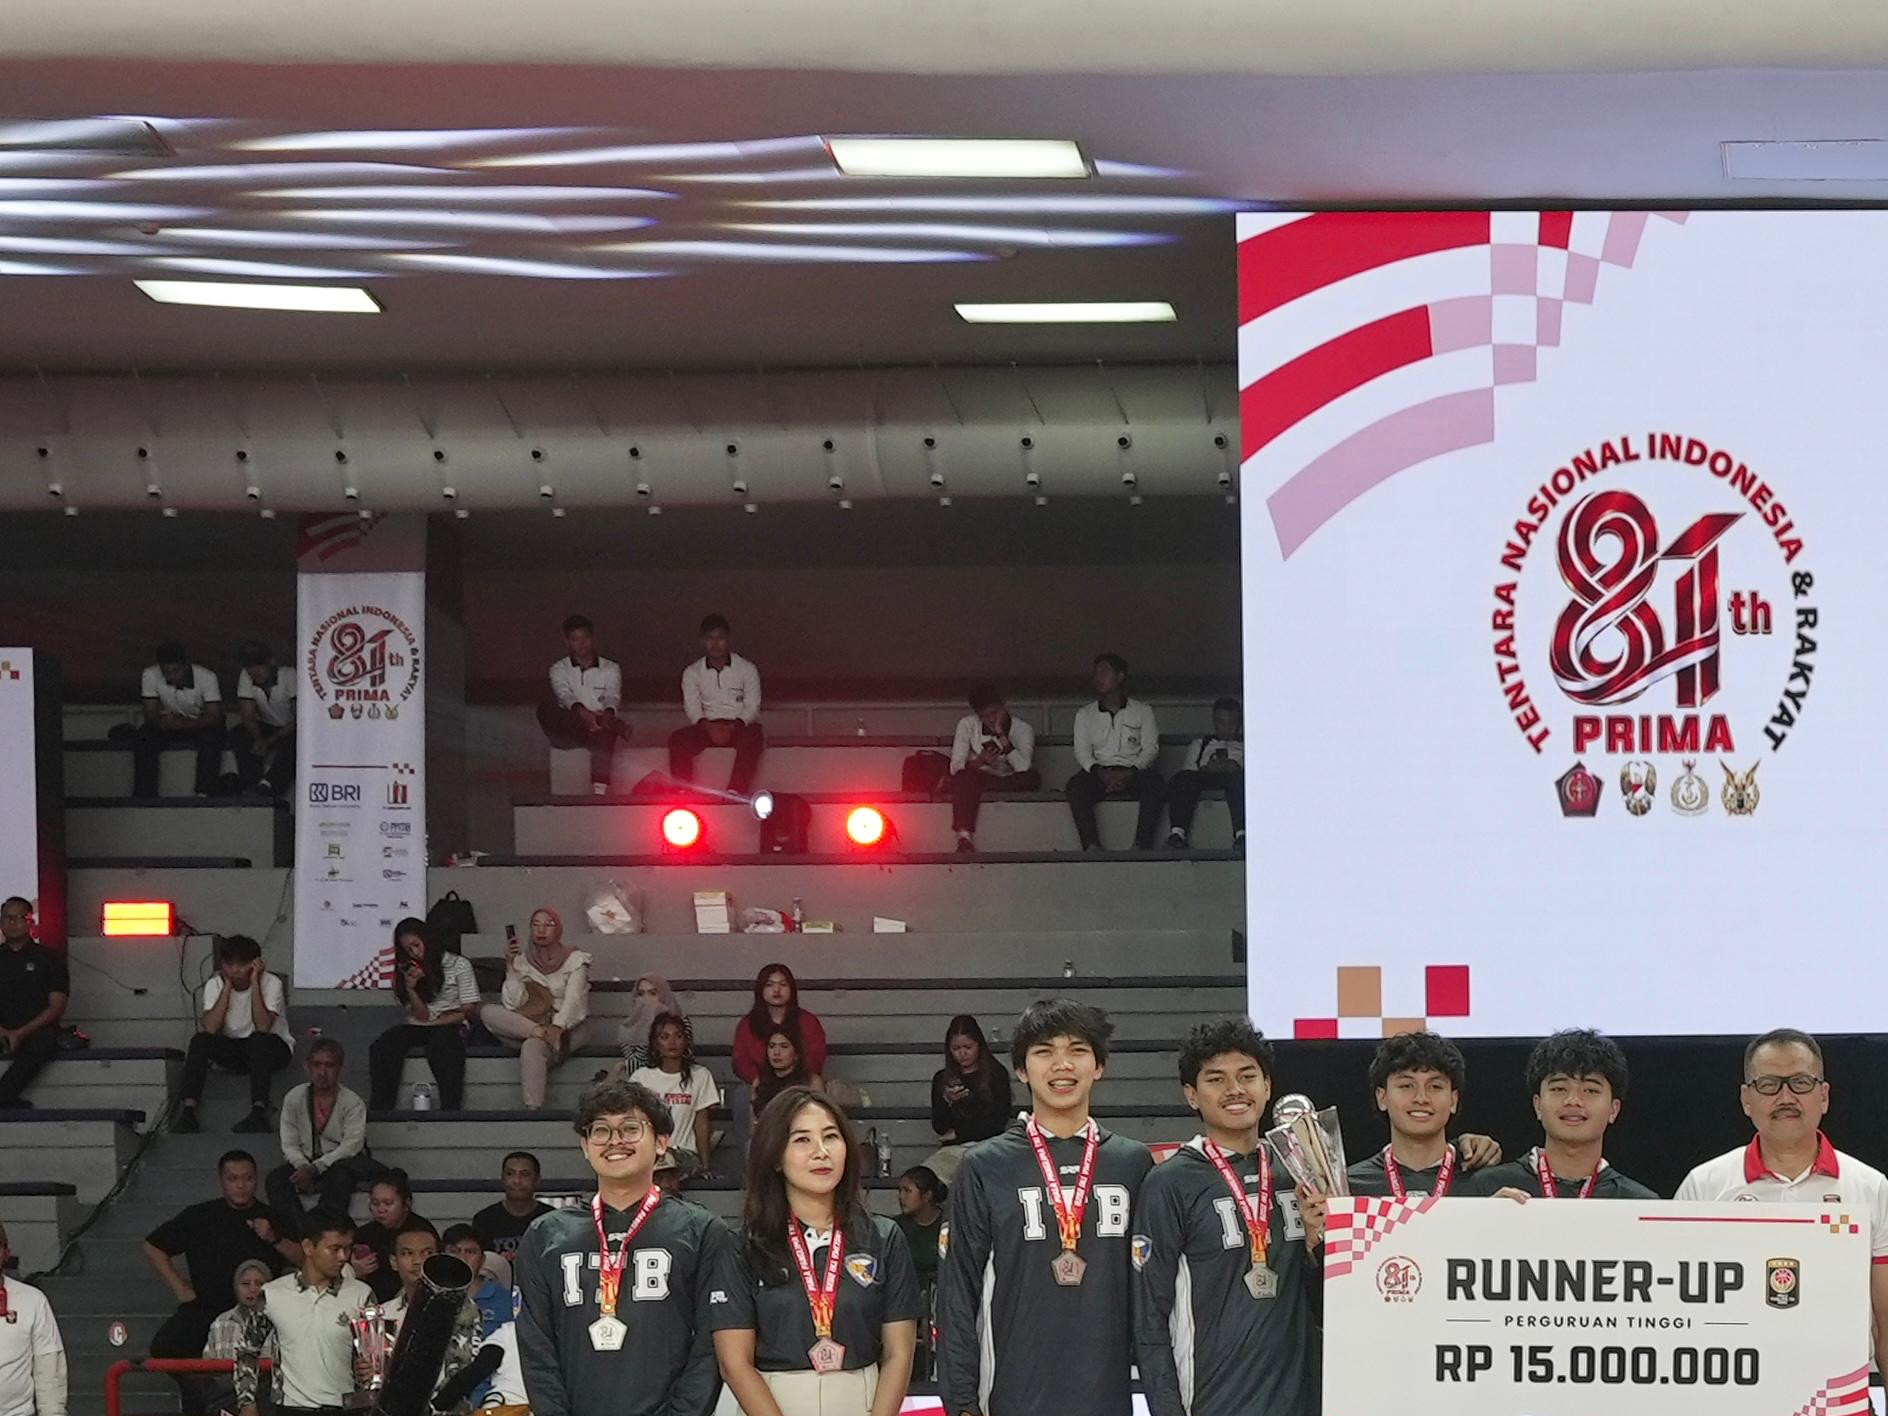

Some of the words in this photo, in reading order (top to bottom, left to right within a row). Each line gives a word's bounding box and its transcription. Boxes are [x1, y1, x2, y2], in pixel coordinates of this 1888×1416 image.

[1500, 436, 1640, 571] NASIONAL
[1648, 432, 1805, 565] INDONESIA
[1791, 570, 1814, 599] &
[1492, 580, 1552, 755] TENTARA
[1762, 607, 1818, 752] RAKYAT
[335, 689, 390, 701] PRIMA
[1572, 713, 1735, 754] PRIMA
[331, 784, 361, 801] BRI
[1446, 1258, 1744, 1304] RUNNER-UP
[1504, 1315, 1618, 1328] PERGURUAN
[1627, 1316, 1692, 1329] TINGGI
[1435, 1344, 1493, 1383] RP
[1510, 1345, 1760, 1386] 15.000.000
